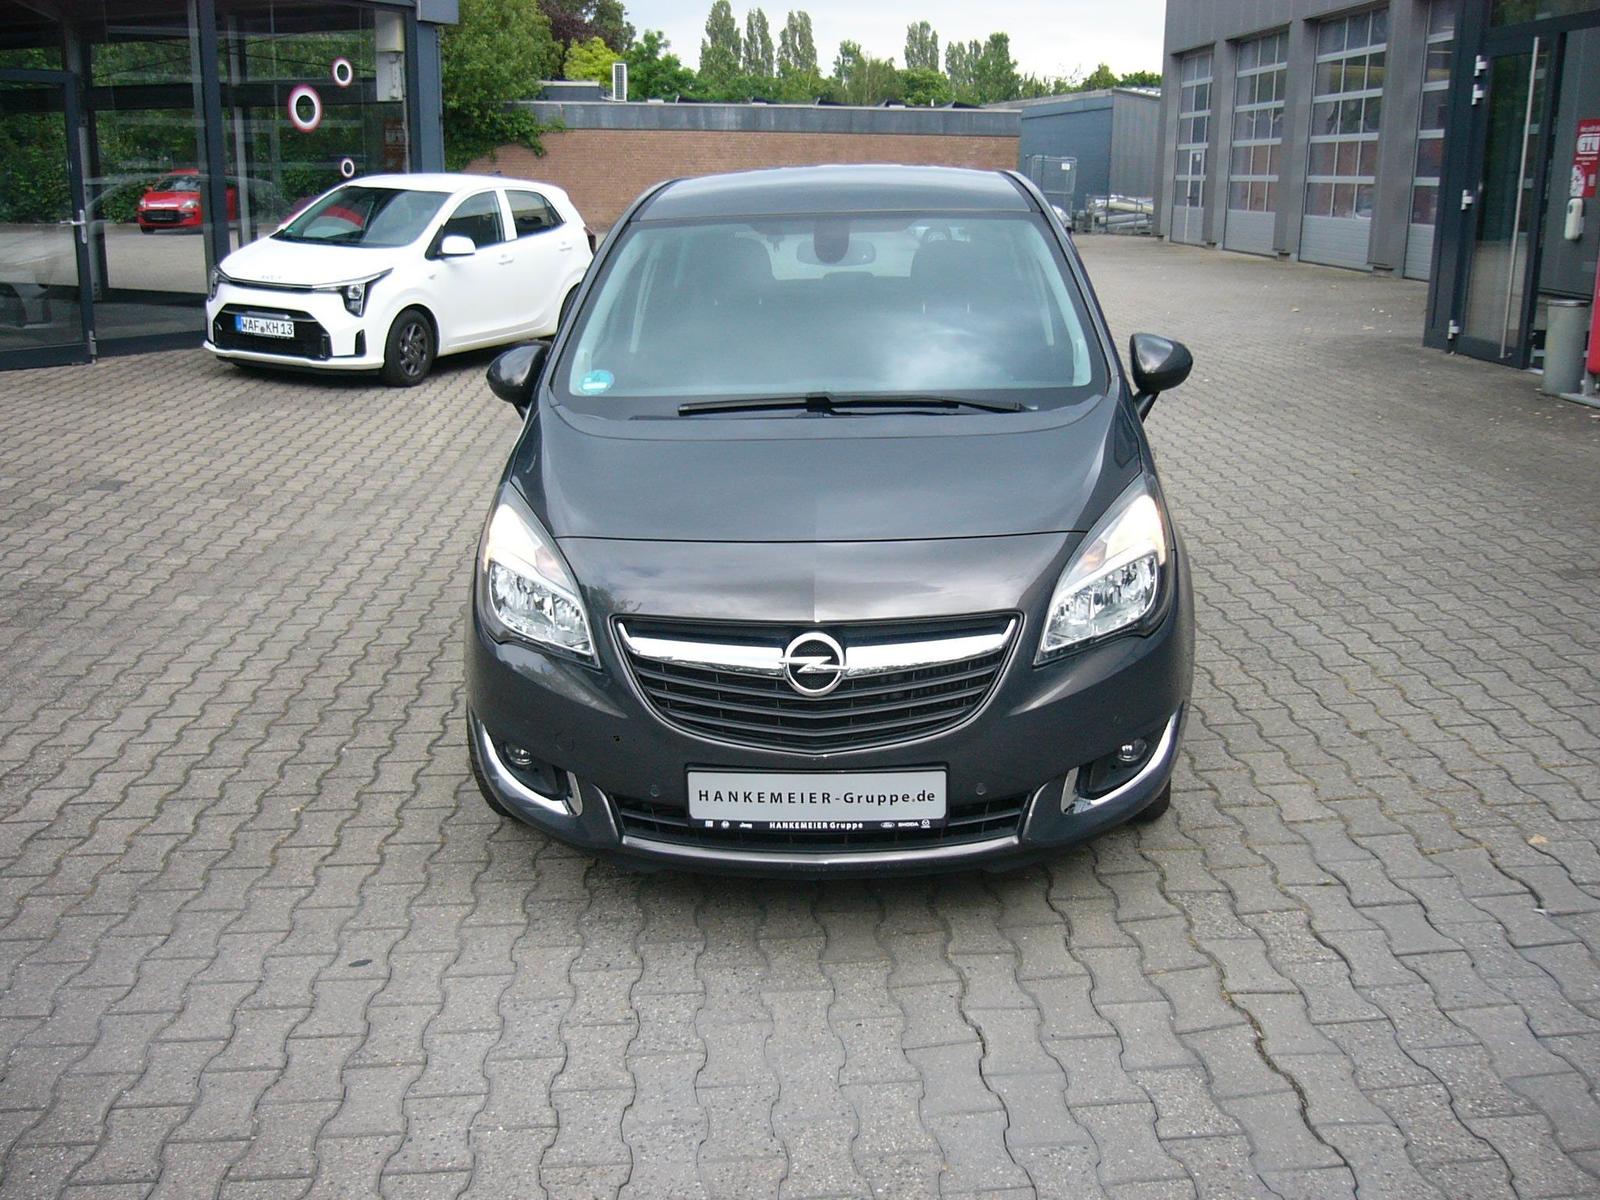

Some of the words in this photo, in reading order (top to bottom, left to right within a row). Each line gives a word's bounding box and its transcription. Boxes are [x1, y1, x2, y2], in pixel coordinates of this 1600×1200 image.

[242, 318, 259, 331] WAF
[266, 321, 279, 333] KH
[281, 323, 293, 335] 13
[698, 789, 935, 806] HANKEMEIER-Gruppe.de
[769, 821, 828, 829] HANKEMEIER
[829, 821, 863, 830] Gruppe
